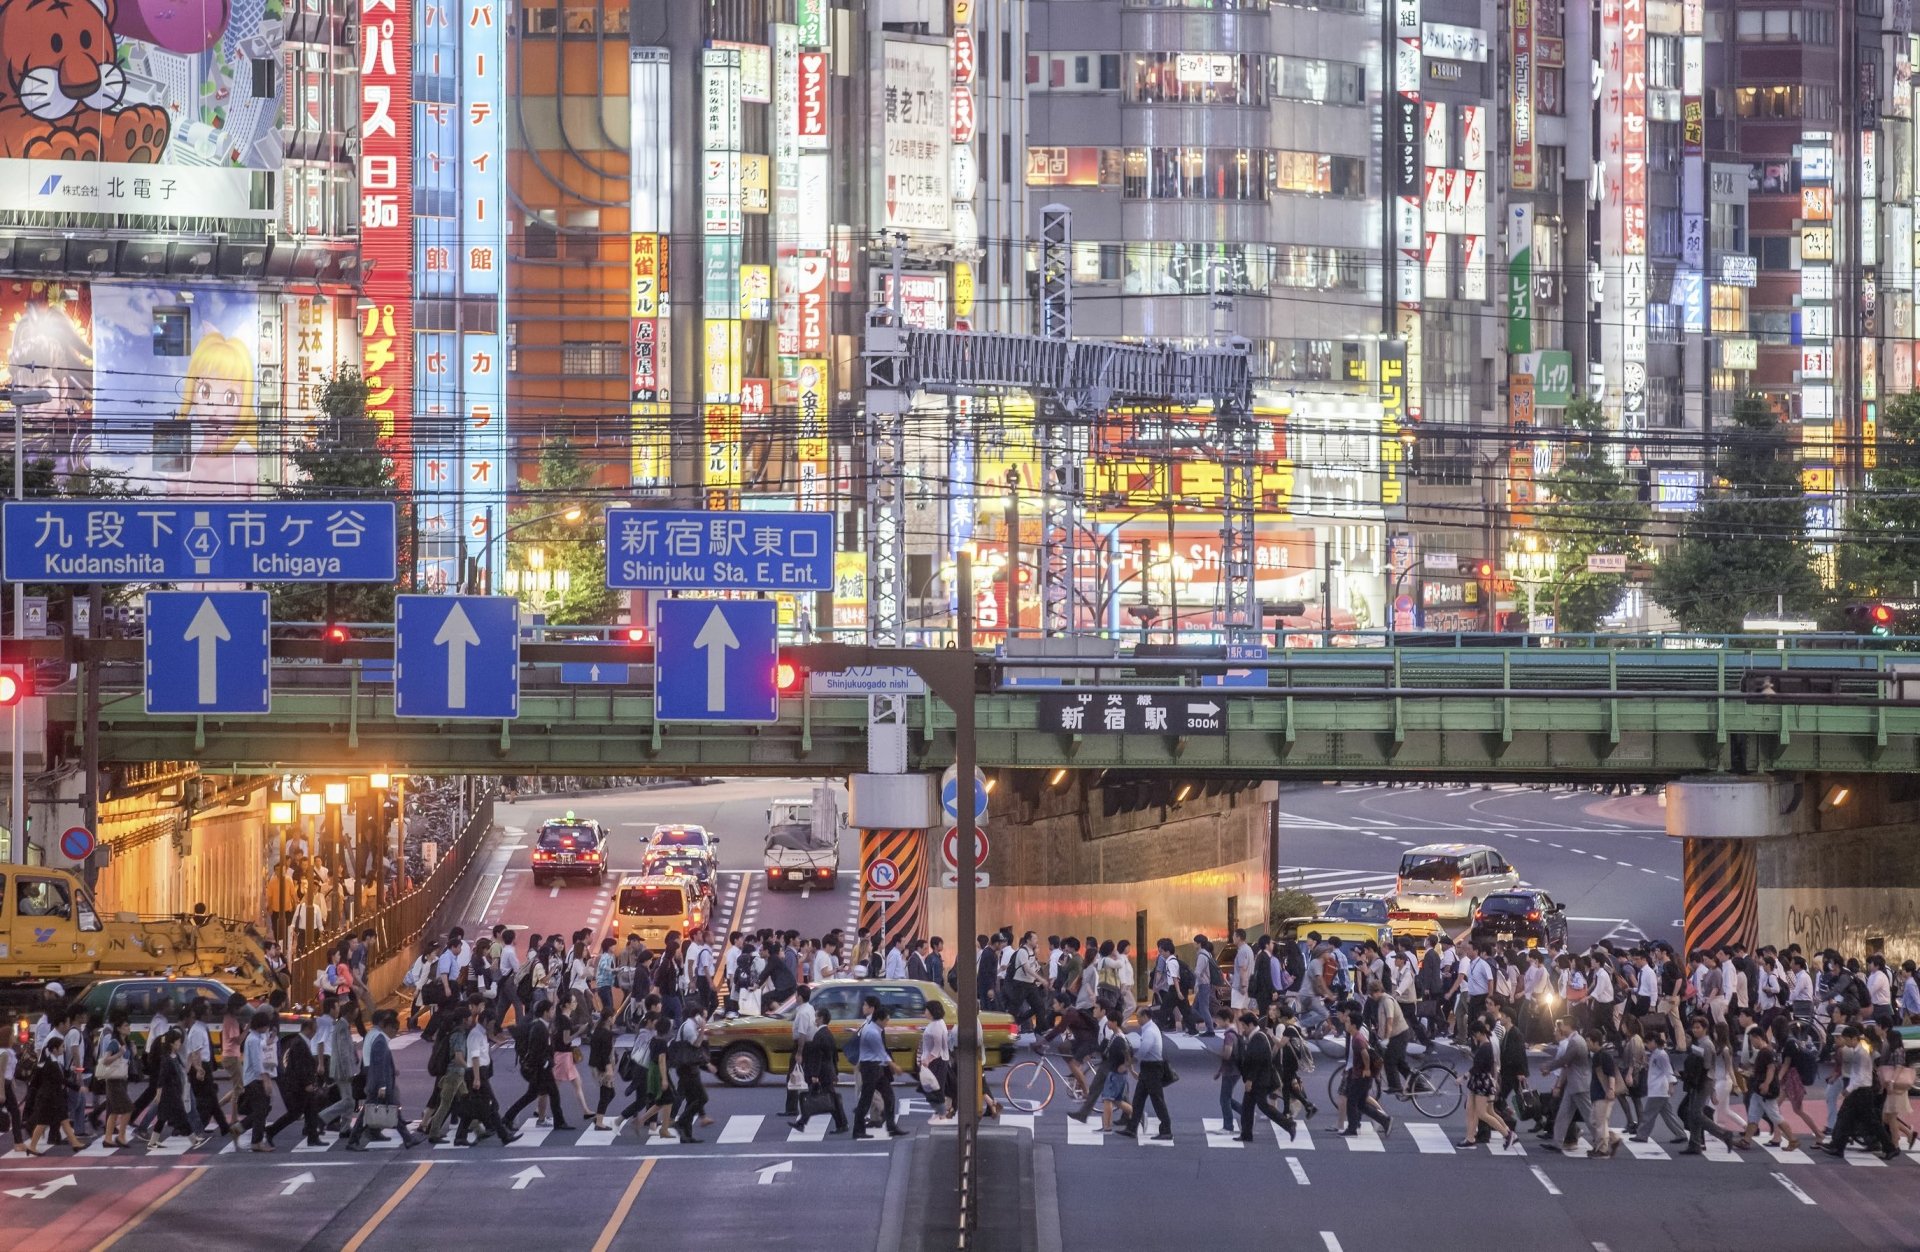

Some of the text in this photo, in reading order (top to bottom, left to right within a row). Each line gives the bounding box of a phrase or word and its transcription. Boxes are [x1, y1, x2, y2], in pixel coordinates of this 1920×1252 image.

[742, 83, 764, 95] マンボー
[804, 73, 822, 134] アイフル
[361, 0, 398, 228] パス日拓
[1610, 42, 1619, 206] カラオケ
[1686, 103, 1701, 143] 麻雀
[470, 5, 492, 271] パーティー館
[1403, 104, 1413, 184] ザ・ロックアップ
[62, 176, 177, 200] 株式会社 北電子
[805, 294, 820, 337] アコム
[1513, 277, 1527, 321] レイク
[1627, 262, 1641, 337] パーティー
[1686, 276, 1701, 322] 747
[298, 298, 309, 410] 超大型店
[636, 322, 655, 375] 居酒屋
[806, 339, 820, 350] 3F
[363, 304, 397, 437] パチンコ
[1542, 364, 1568, 393] レイク
[471, 352, 491, 537] カラオケ
[34, 510, 177, 549] 九段下
[620, 518, 819, 558] 新宿駅東口
[45, 533, 341, 576] Kudanshita 4 Ichigaya
[623, 560, 818, 583] Shinjuku Sta. E. Ent.
[839, 574, 864, 598] 金の蔵
[827, 679, 909, 690] Shinjukuogado nishi
[1061, 706, 1219, 730] 新宿駅 300M
